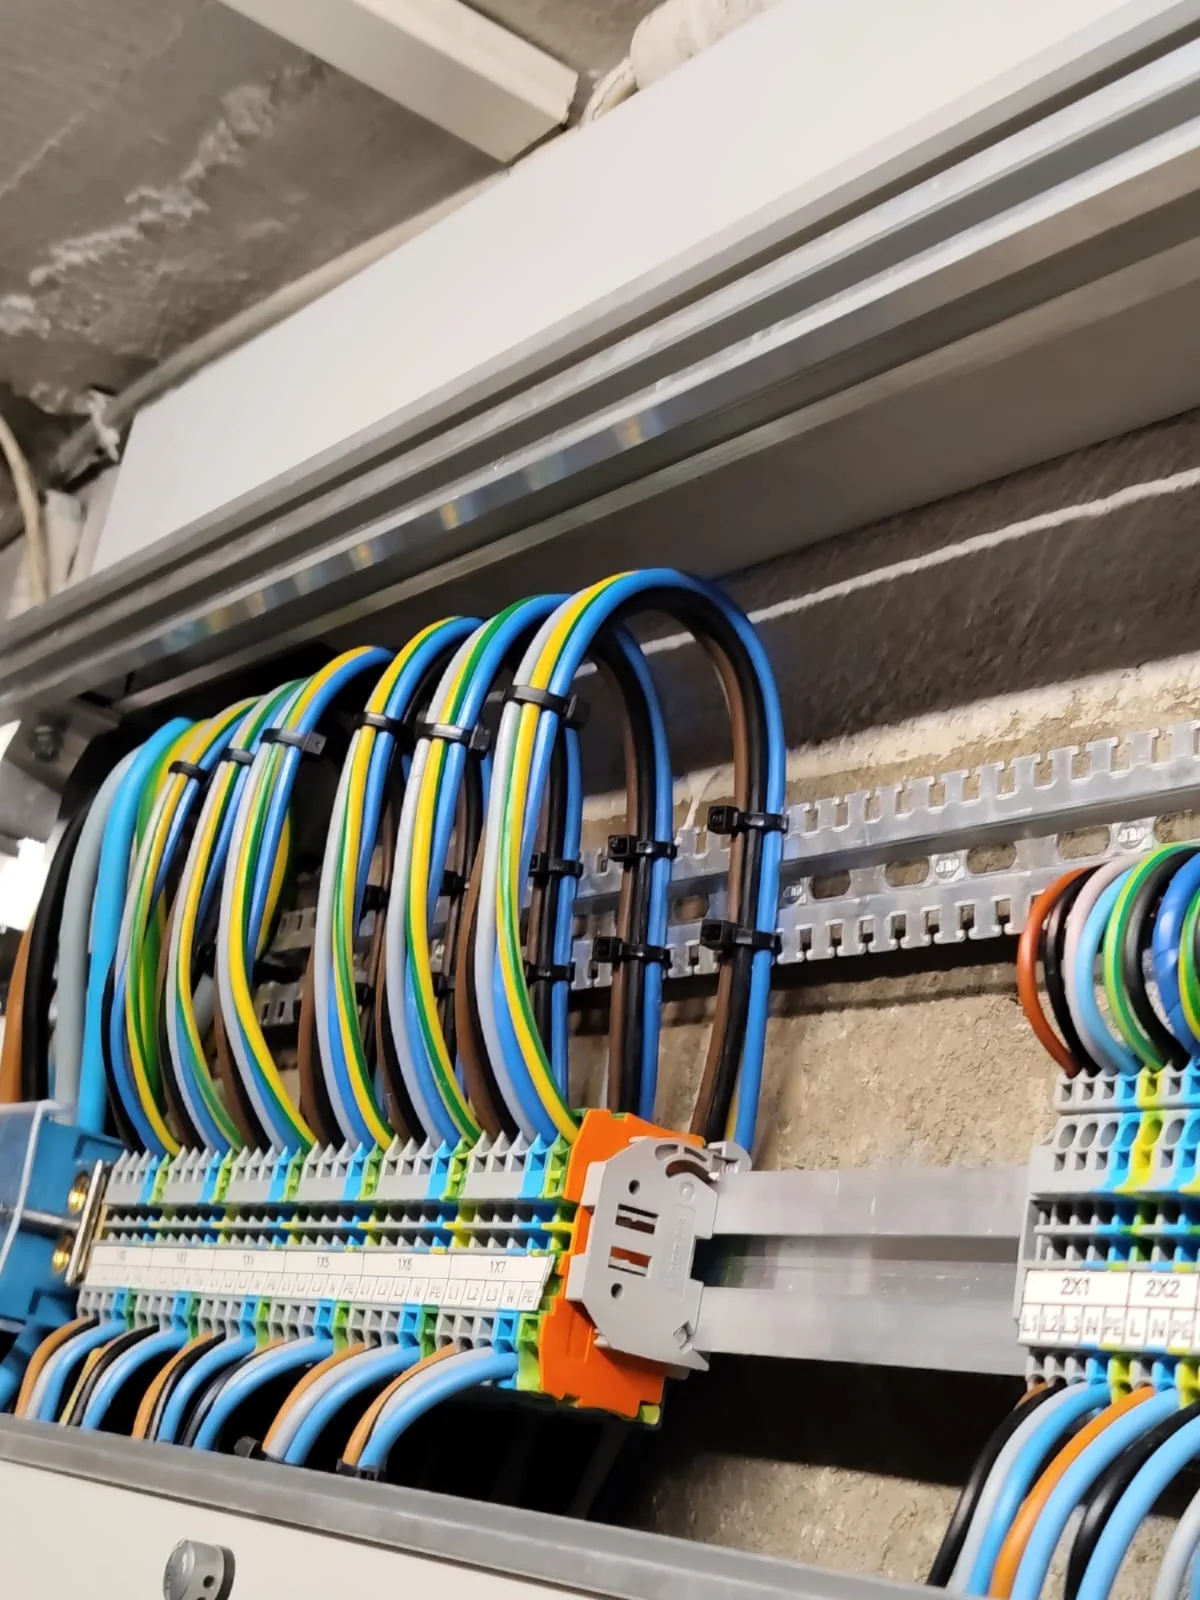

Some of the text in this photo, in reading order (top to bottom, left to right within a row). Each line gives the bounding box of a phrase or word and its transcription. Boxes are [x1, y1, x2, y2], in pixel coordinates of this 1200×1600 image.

[489, 1260, 507, 1274] 1X7
[1060, 1276, 1091, 1296] 2X1
[1144, 1278, 1180, 1299] 2X2
[1129, 1317, 1142, 1337] L
